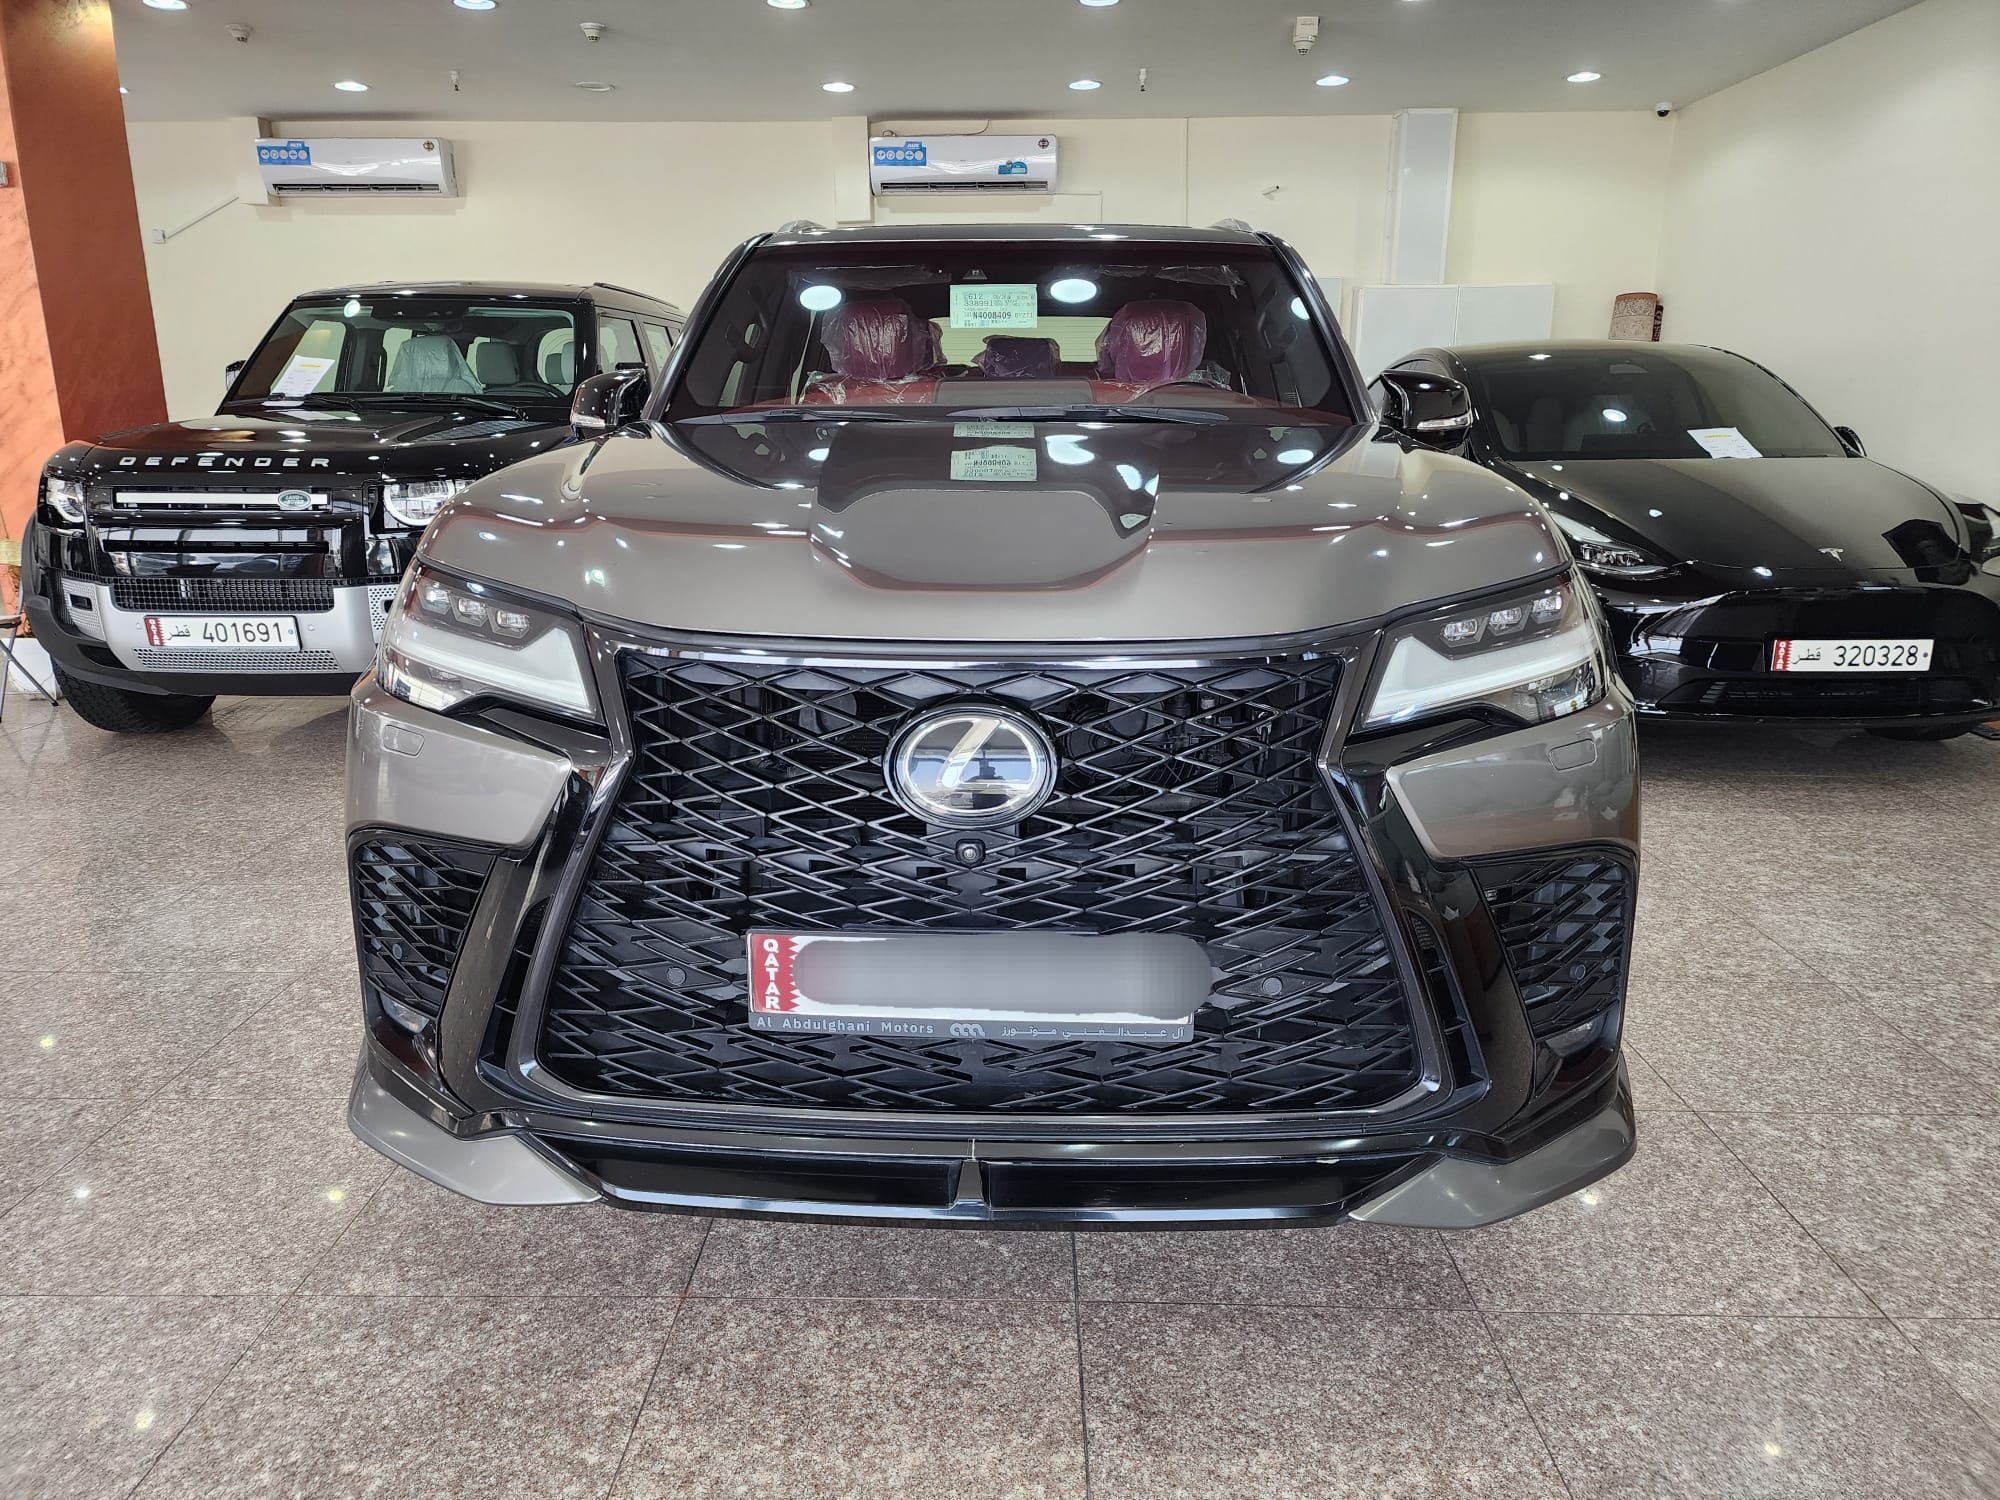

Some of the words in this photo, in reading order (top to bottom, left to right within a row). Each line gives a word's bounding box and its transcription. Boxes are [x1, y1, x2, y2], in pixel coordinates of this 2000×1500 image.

[973, 311, 1012, 320] N4008409
[119, 456, 330, 468] DEFENDER
[166, 624, 191, 641] قطر
[202, 622, 283, 643] 401691
[1791, 647, 1822, 665] قطر
[1833, 645, 1919, 667] 320328
[763, 938, 781, 1010] QATAR
[756, 1016, 772, 1028] Al
[782, 1017, 871, 1033] Abdulghani
[881, 1021, 935, 1034] Motors
[1001, 1024, 1057, 1037] موتورز
